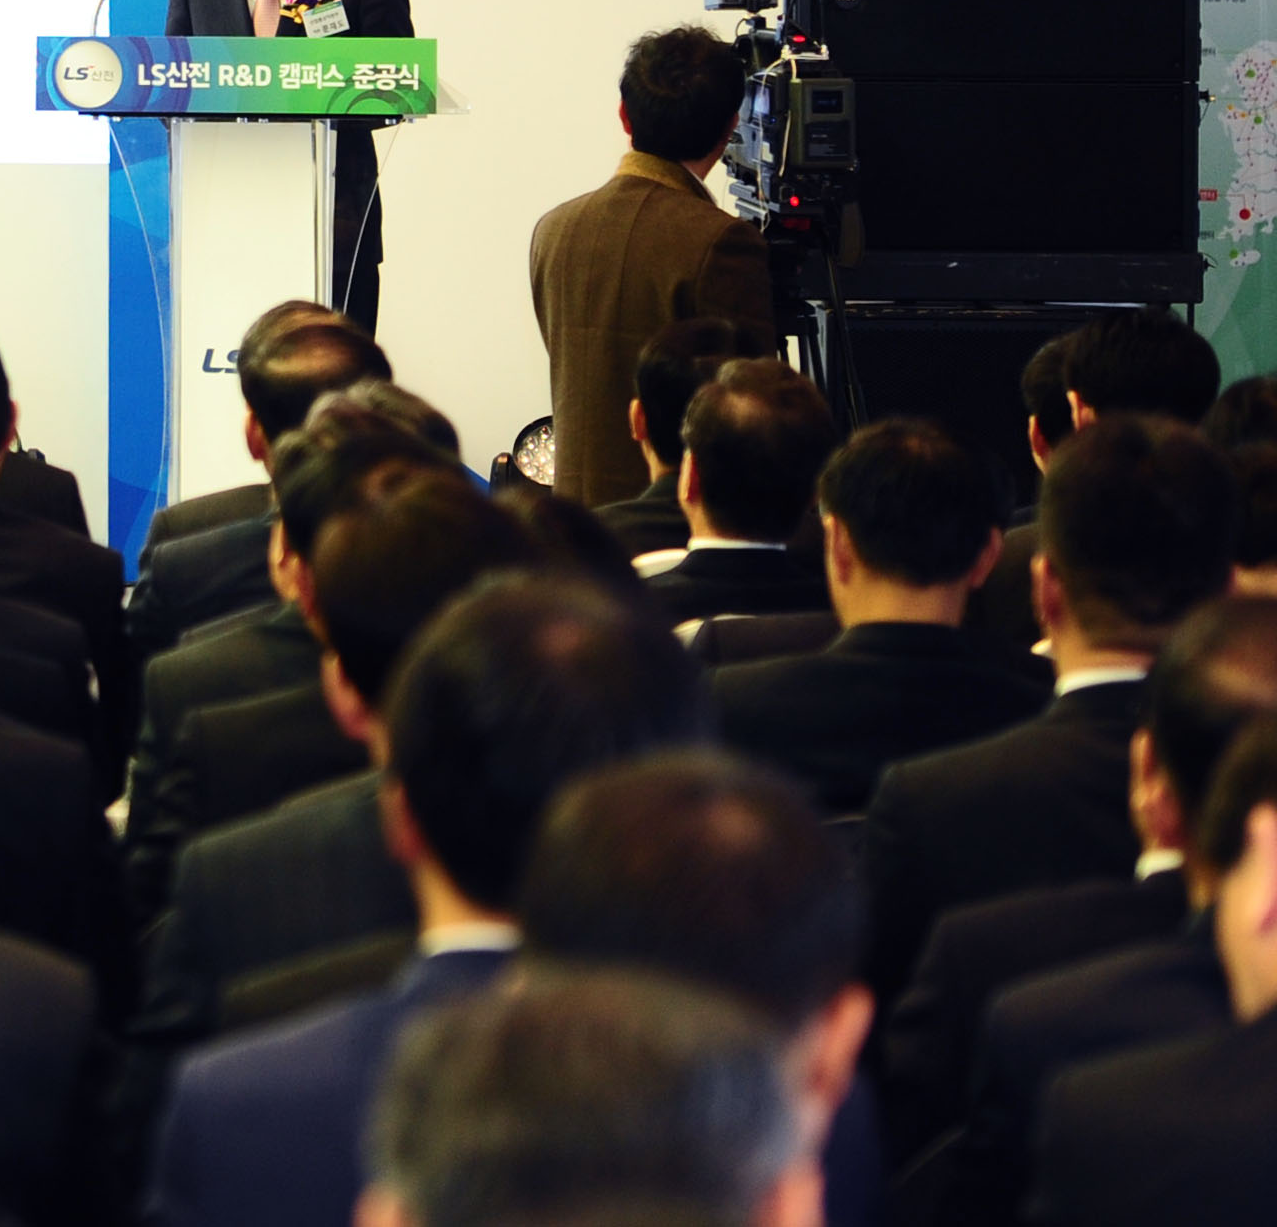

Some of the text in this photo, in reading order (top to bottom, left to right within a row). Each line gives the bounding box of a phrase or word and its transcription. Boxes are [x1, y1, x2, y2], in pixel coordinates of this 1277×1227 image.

[137, 63, 420, 91] LS산전 R&D 캠퍼스 준공식
